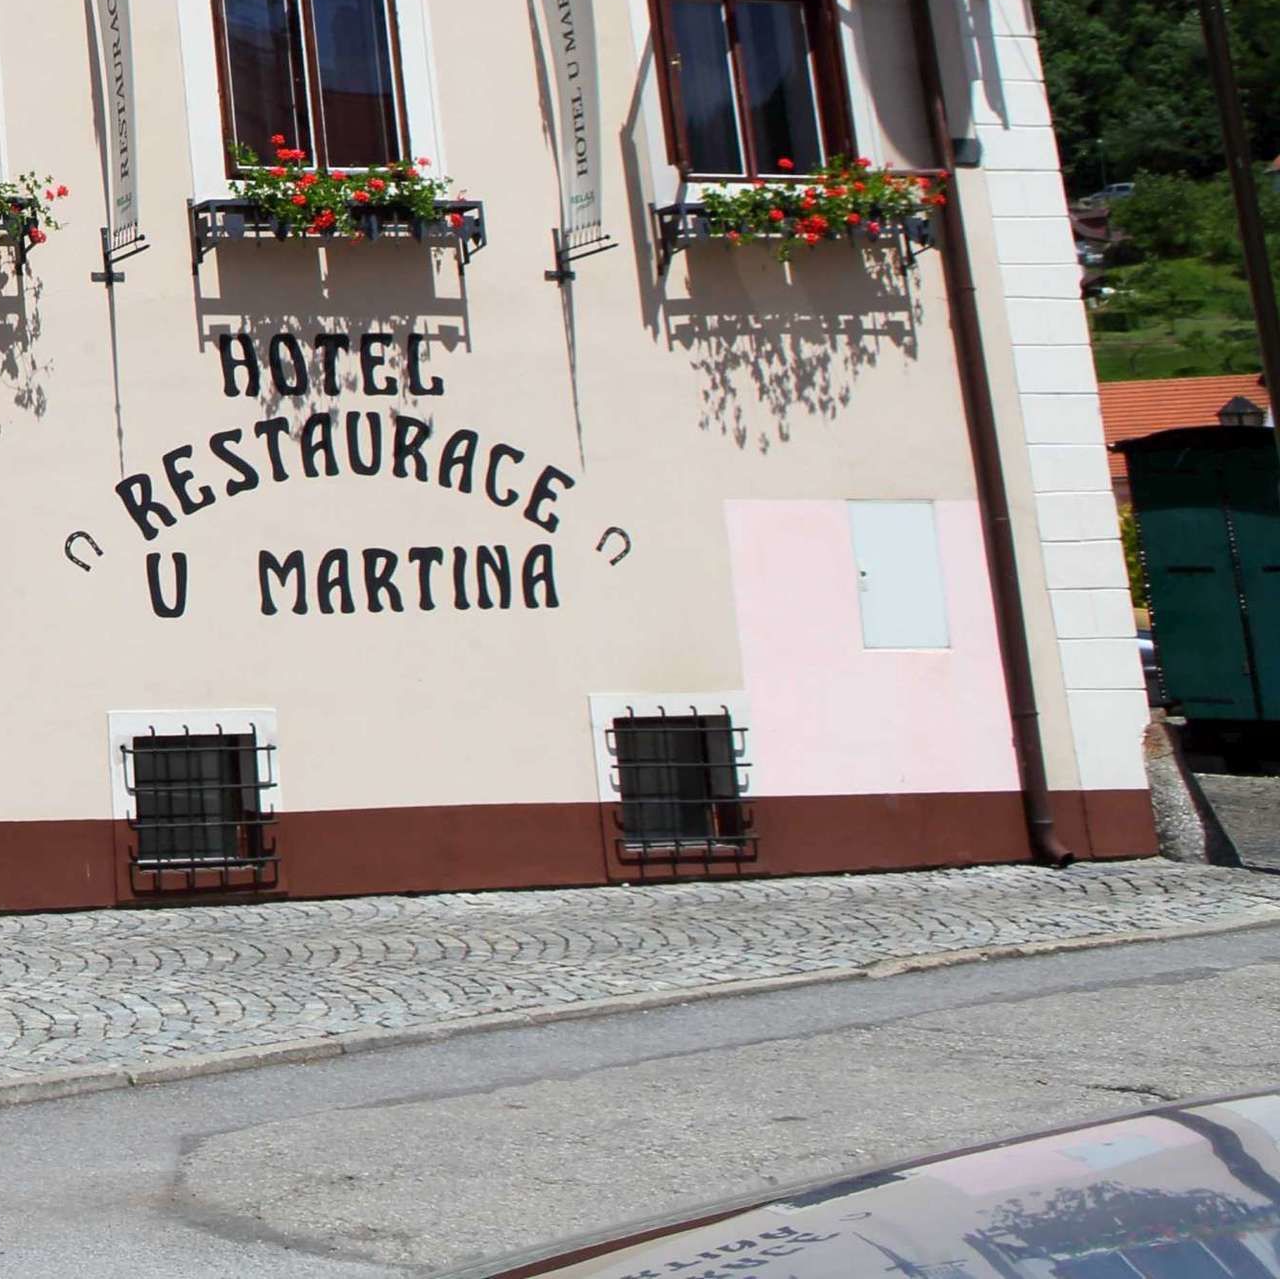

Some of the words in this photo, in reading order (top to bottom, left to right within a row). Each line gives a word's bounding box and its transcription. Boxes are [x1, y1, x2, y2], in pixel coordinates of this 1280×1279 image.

[567, 60, 580, 81] U
[570, 86, 588, 177] HOTEL
[218, 332, 445, 397] HOTEL
[115, 410, 575, 541] RESTAURACE
[145, 552, 188, 619] U
[258, 543, 560, 616] MARTINA
